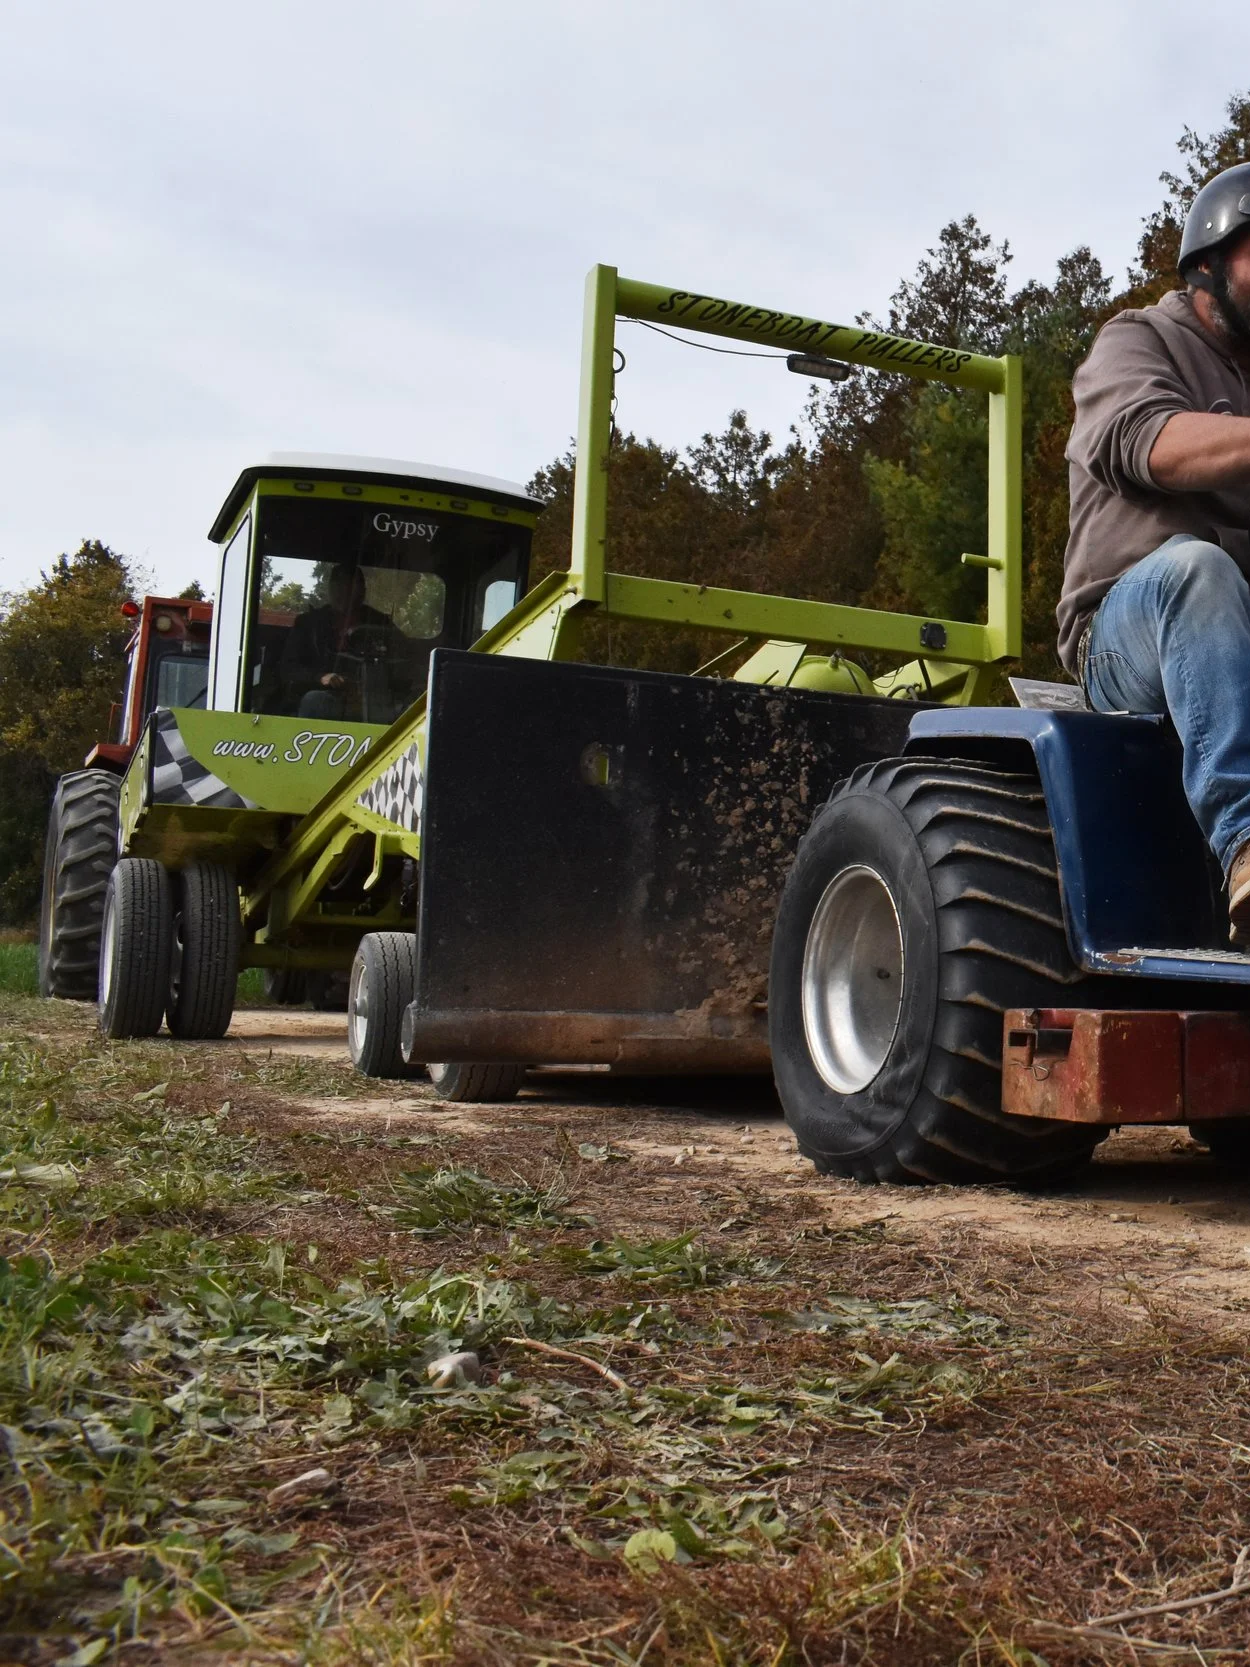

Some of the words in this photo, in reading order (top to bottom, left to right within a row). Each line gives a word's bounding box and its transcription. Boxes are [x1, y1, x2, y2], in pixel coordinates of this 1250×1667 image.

[657, 290, 849, 346] STONEBOAT
[849, 332, 973, 374] PULLERS
[373, 512, 440, 542] Gypsy
